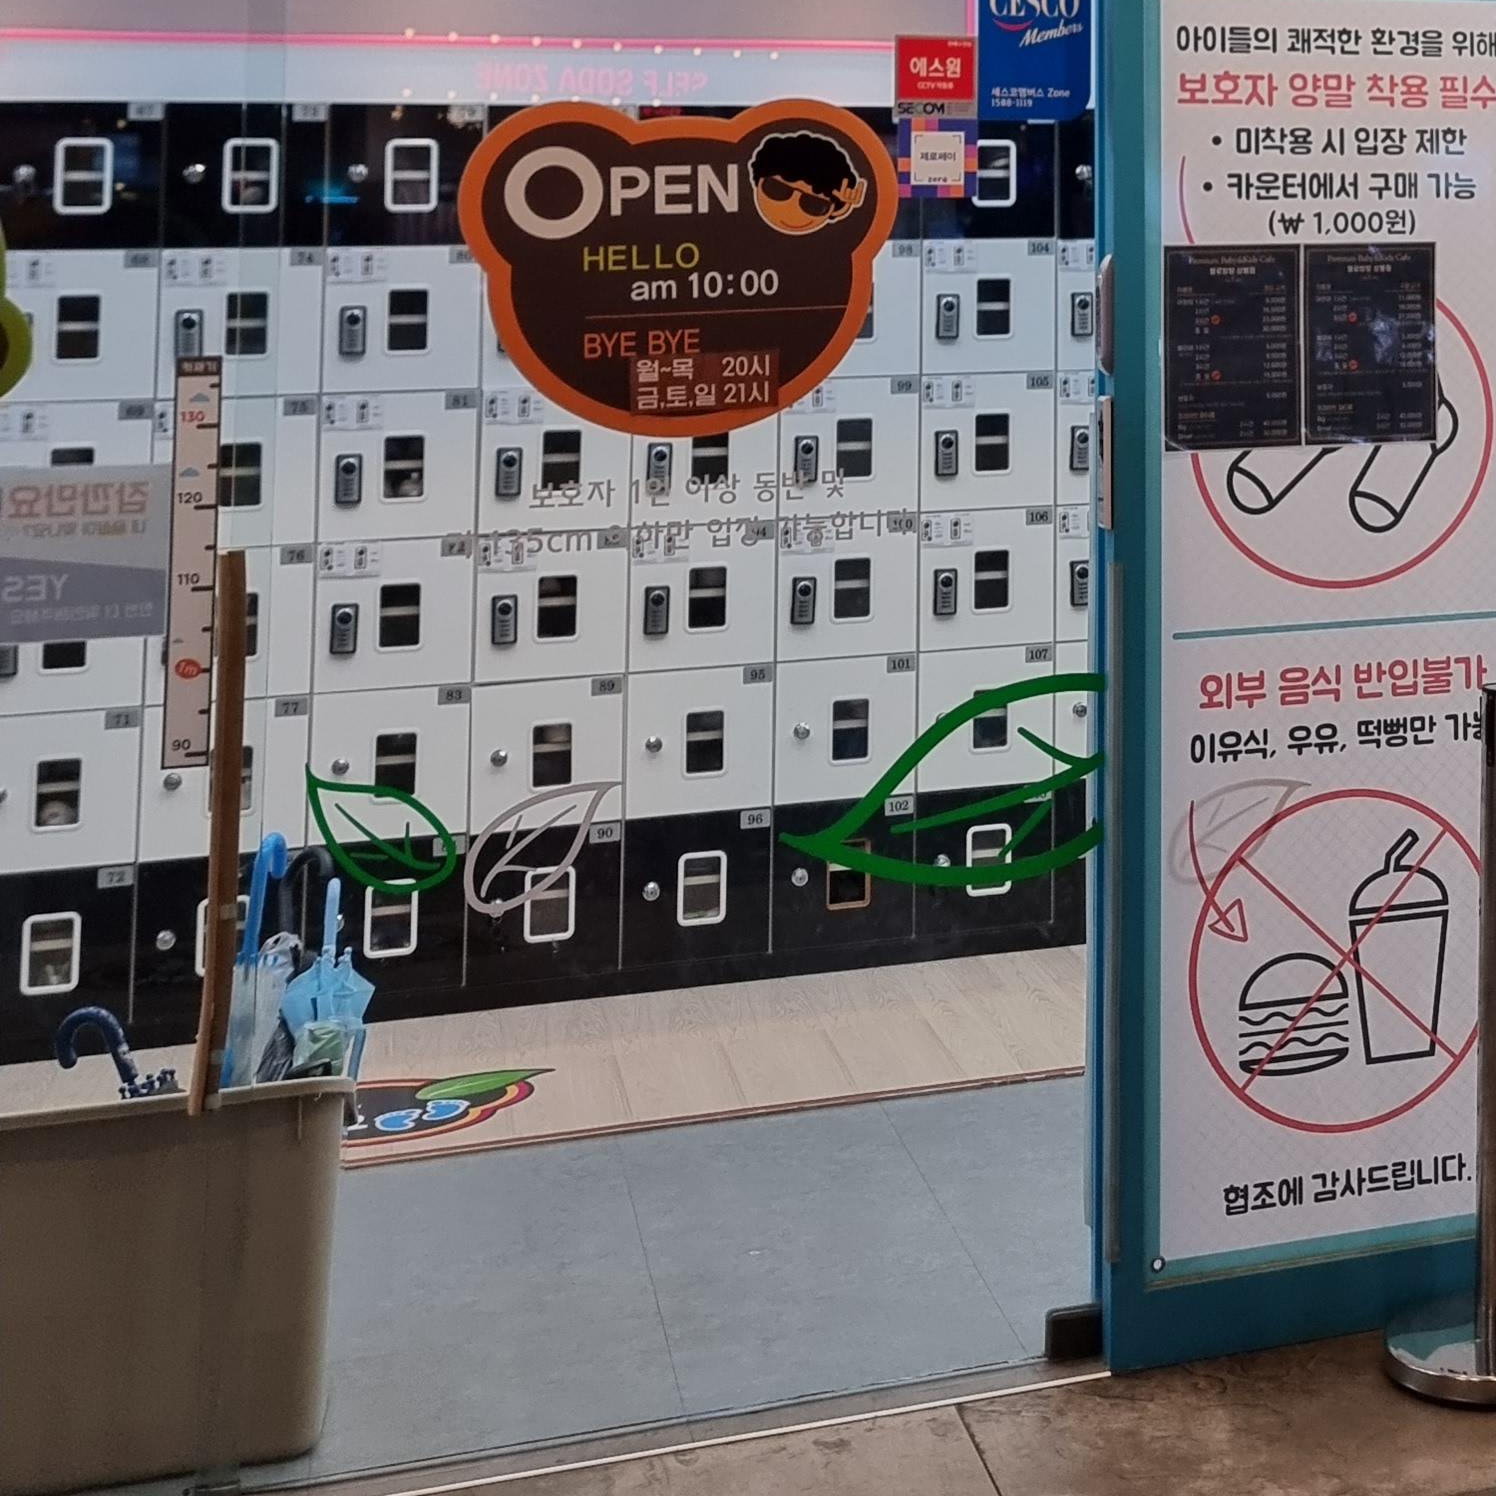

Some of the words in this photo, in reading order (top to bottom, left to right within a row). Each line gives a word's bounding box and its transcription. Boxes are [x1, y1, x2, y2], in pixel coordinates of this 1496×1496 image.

[1019, 19, 1084, 48] Members
[1176, 25, 1278, 54] 아이들의
[1287, 27, 1362, 56] 쾌적한
[1371, 28, 1443, 58] 환경을
[910, 56, 962, 79] 에스원
[1047, 87, 1071, 98] Zone
[1177, 70, 1279, 107] 보호자
[1288, 73, 1356, 108] 양말
[1366, 74, 1429, 109] 착용
[897, 102, 946, 116] SECOM
[1235, 126, 1313, 156] 미착용
[1321, 127, 1345, 156] 시
[1354, 126, 1407, 156] 입장
[1415, 126, 1468, 156] 제한
[504, 146, 739, 240] OPEN
[1227, 172, 1359, 201] 카운터에서
[1368, 172, 1418, 200] 구매
[1427, 172, 1478, 200] 가능
[1313, 209, 1416, 236] 1,000원)
[1030, 241, 1050, 255] 104
[583, 243, 700, 272] HELLO
[631, 279, 677, 301] am
[688, 269, 779, 298] 10:00
[584, 331, 637, 359] BYE
[648, 328, 700, 356] BYE
[636, 358, 694, 383] 월~목
[721, 355, 771, 378] 20시
[897, 379, 913, 392] 99
[1029, 375, 1050, 389] 105
[723, 380, 770, 404] 21시
[181, 411, 205, 423] 130
[529, 478, 615, 510] 보호자
[685, 473, 741, 505] 이상
[753, 468, 805, 503] 동반
[821, 467, 846, 500] 및
[178, 492, 202, 504] 120
[1028, 509, 1050, 523] 106
[177, 573, 200, 585] 110
[1028, 648, 1050, 661] 107
[890, 657, 911, 670] 101
[749, 668, 766, 681] 95
[599, 680, 616, 693] 89
[1199, 670, 1267, 710] 외부
[1279, 664, 1341, 706] 음식
[1354, 654, 1488, 700] 반입불가
[446, 689, 463, 701] 83
[172, 739, 191, 751] 90
[1190, 728, 1276, 763] 이유식,
[1287, 722, 1347, 756] 우유,
[1357, 715, 1437, 749] 떡뻥만
[888, 799, 910, 813] 102
[746, 813, 764, 827] 96
[596, 826, 613, 840] 90
[1223, 1175, 1303, 1217] 협조에
[1311, 1152, 1473, 1203] 감사드립니다.
